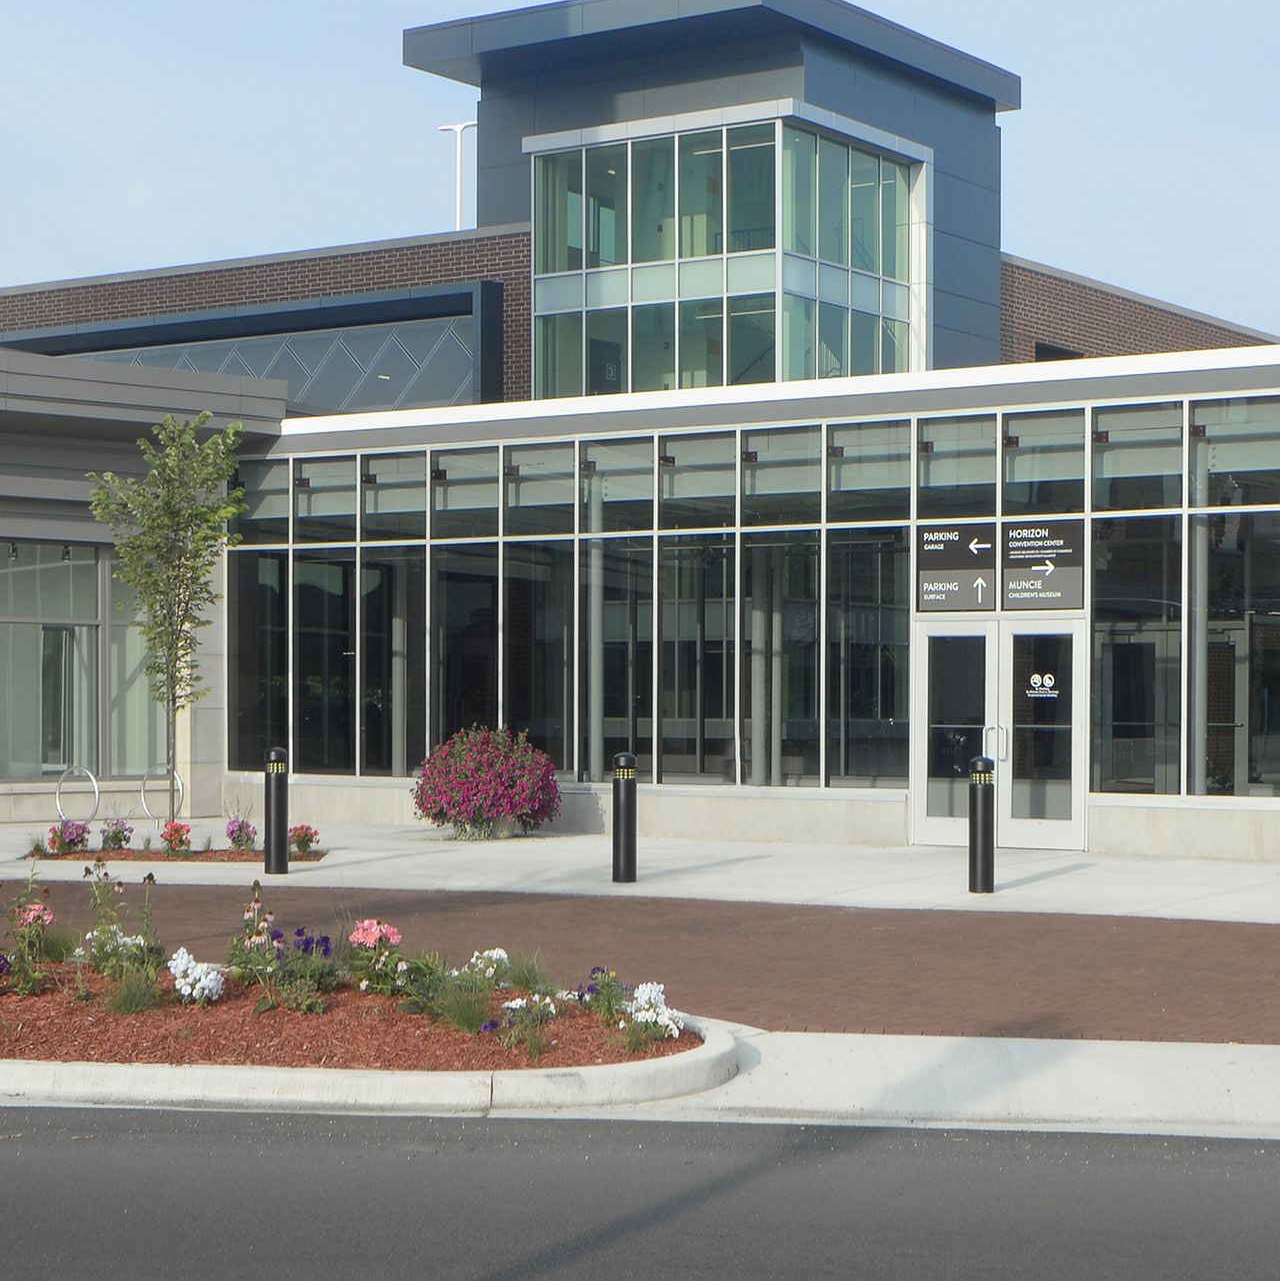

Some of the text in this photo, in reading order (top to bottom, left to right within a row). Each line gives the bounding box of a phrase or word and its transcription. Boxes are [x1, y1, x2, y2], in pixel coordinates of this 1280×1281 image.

[923, 532, 959, 541] PARKING
[1009, 529, 1049, 539] HORIZON
[1008, 540, 1043, 548] CONVENTION
[923, 582, 959, 591] PARKING
[1008, 580, 1043, 589] MUNCIE
